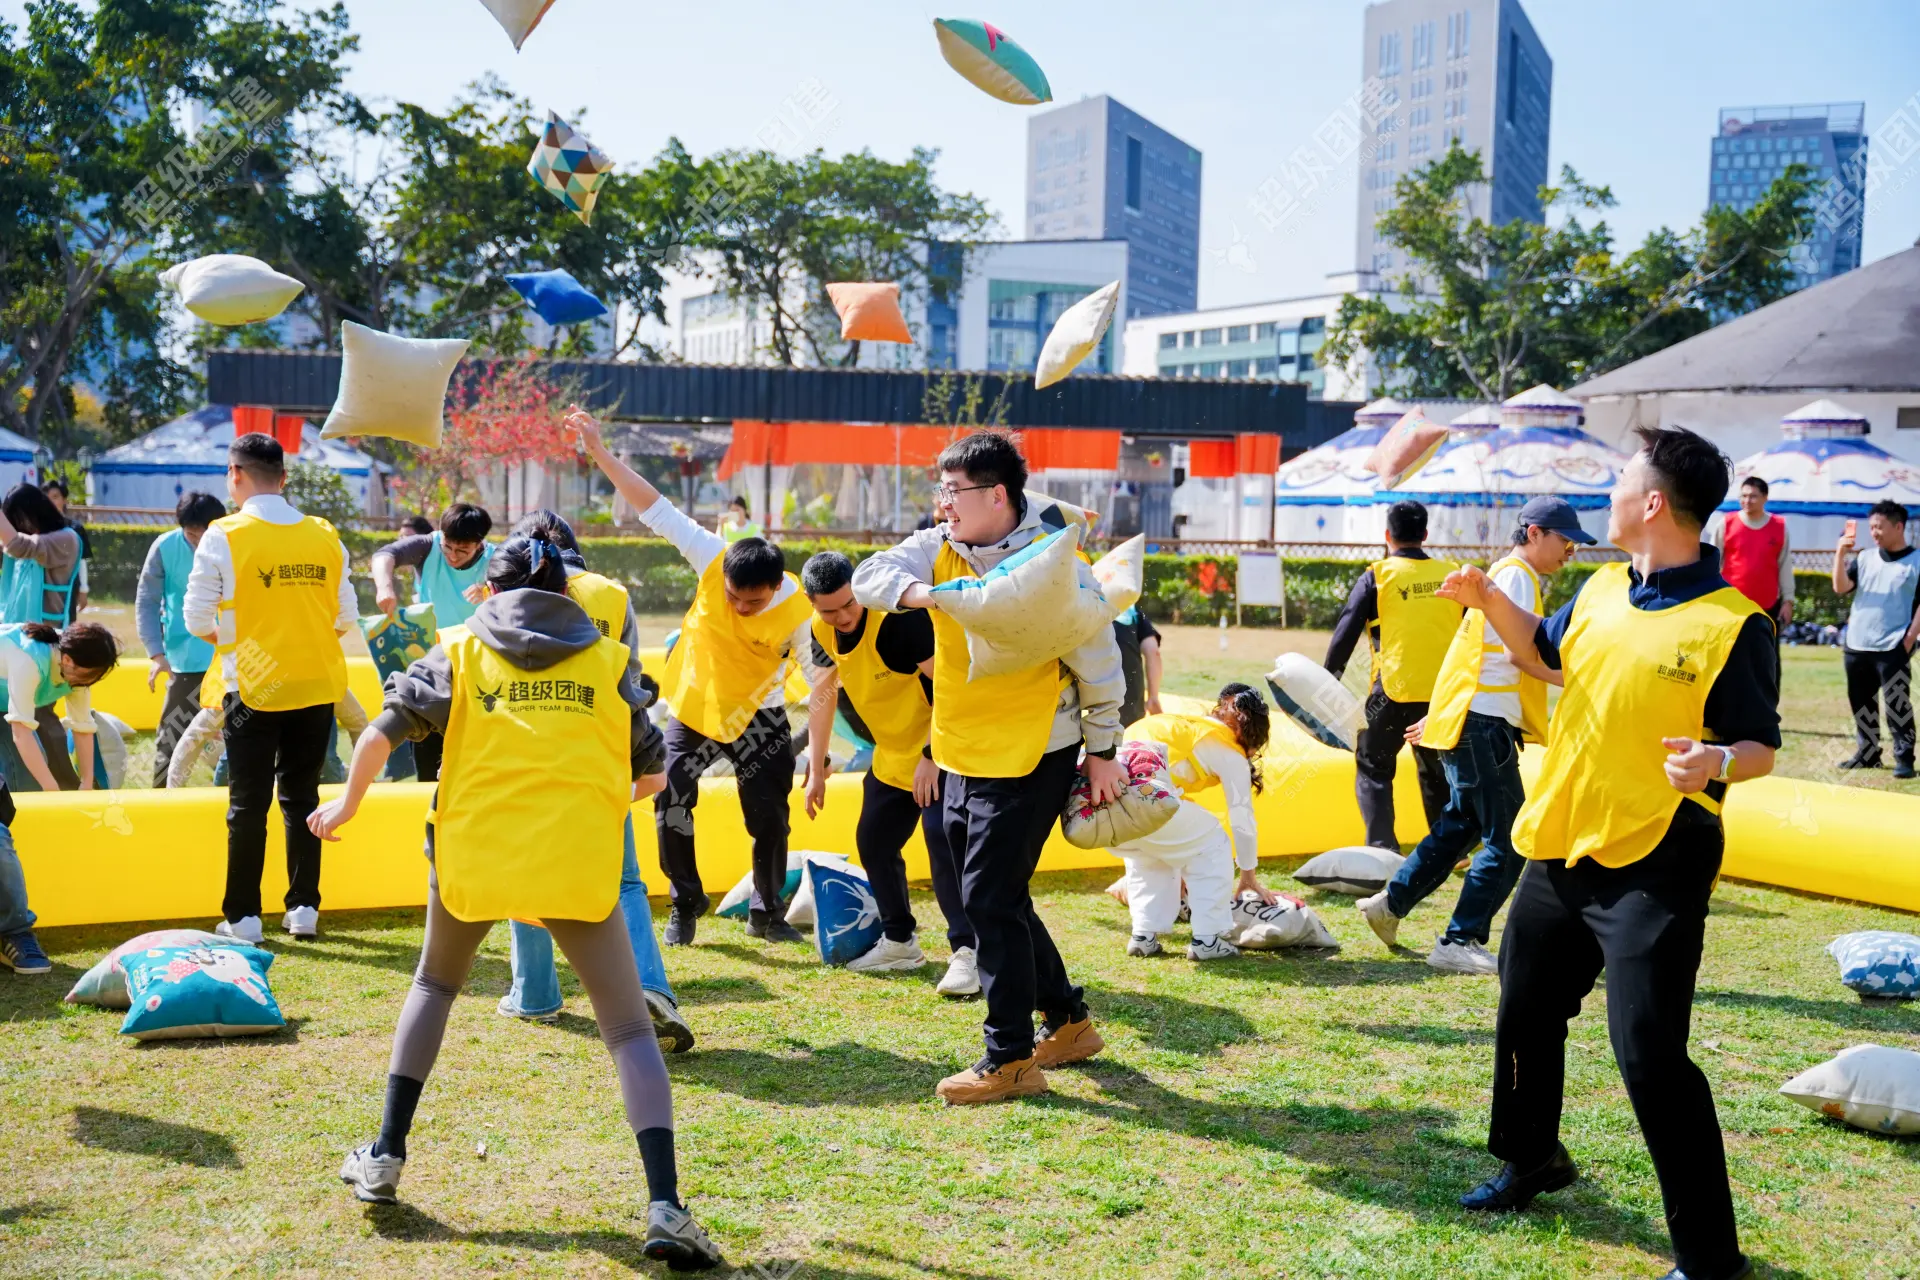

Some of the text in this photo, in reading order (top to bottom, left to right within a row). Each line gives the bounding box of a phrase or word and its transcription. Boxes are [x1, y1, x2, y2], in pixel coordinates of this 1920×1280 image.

[278, 564, 327, 580] 超级团建
[508, 680, 595, 709] 超级团建
[508, 705, 536, 713] SUPER
